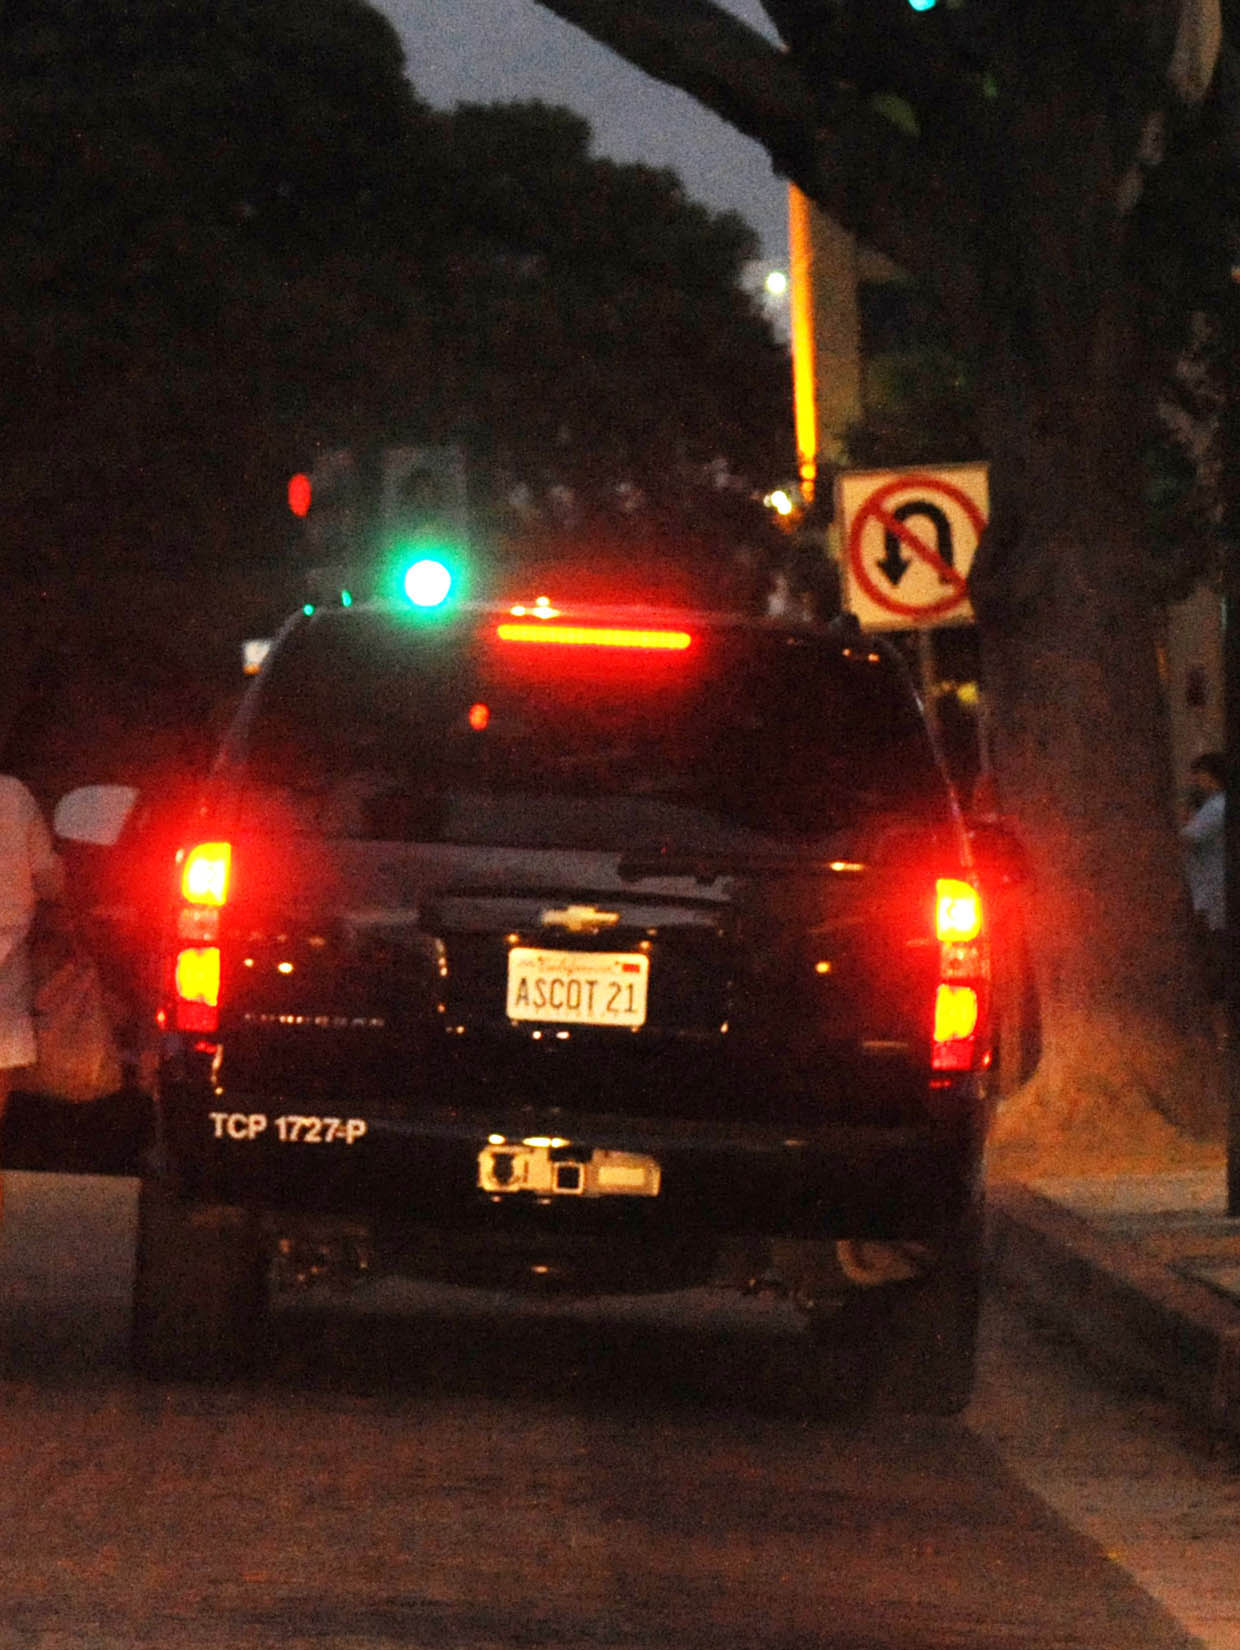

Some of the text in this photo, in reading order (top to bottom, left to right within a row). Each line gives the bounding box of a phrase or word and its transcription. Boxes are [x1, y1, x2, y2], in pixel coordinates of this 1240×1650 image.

[515, 977, 637, 1014] ASCOT 21
[209, 1111, 368, 1145] TCP 1727-P
